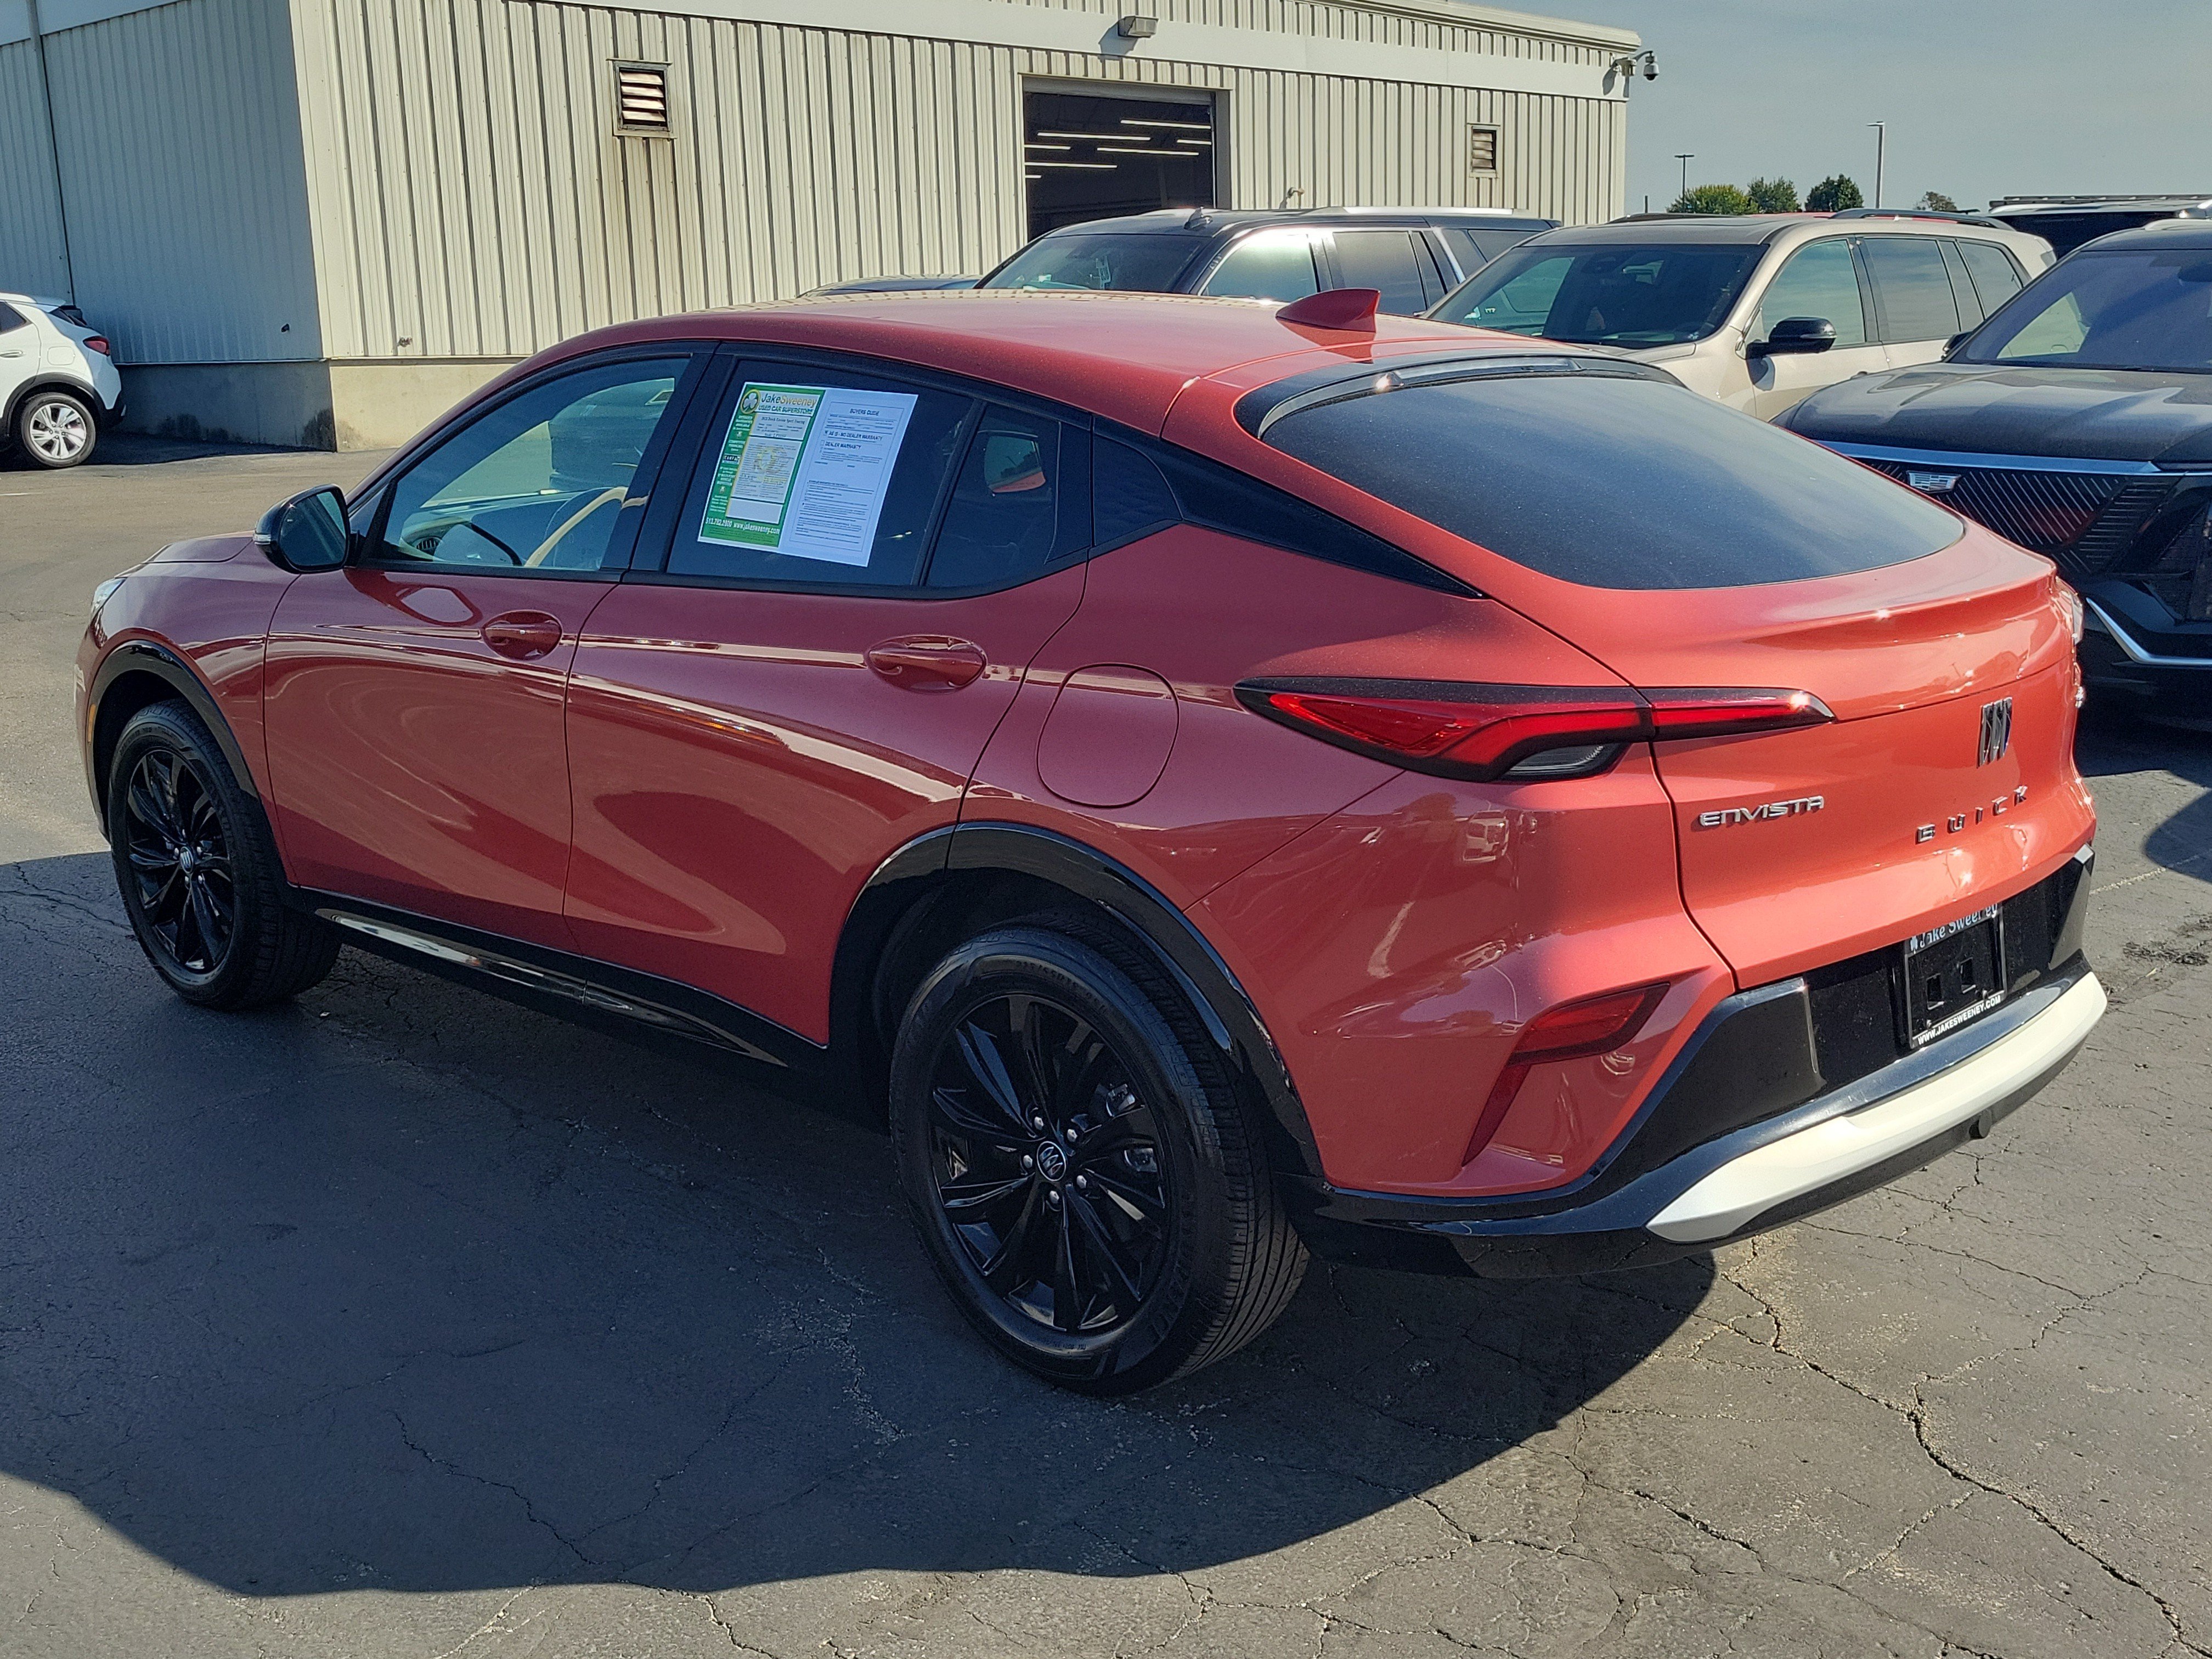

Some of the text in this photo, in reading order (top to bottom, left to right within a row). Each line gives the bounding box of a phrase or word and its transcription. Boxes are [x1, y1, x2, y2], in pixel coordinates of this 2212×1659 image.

[1700, 795, 1824, 826] ENVISTA
[1916, 786, 2028, 844] BUICK
[1918, 995, 2001, 1045] WWW.JAKESWEENEY.COM
